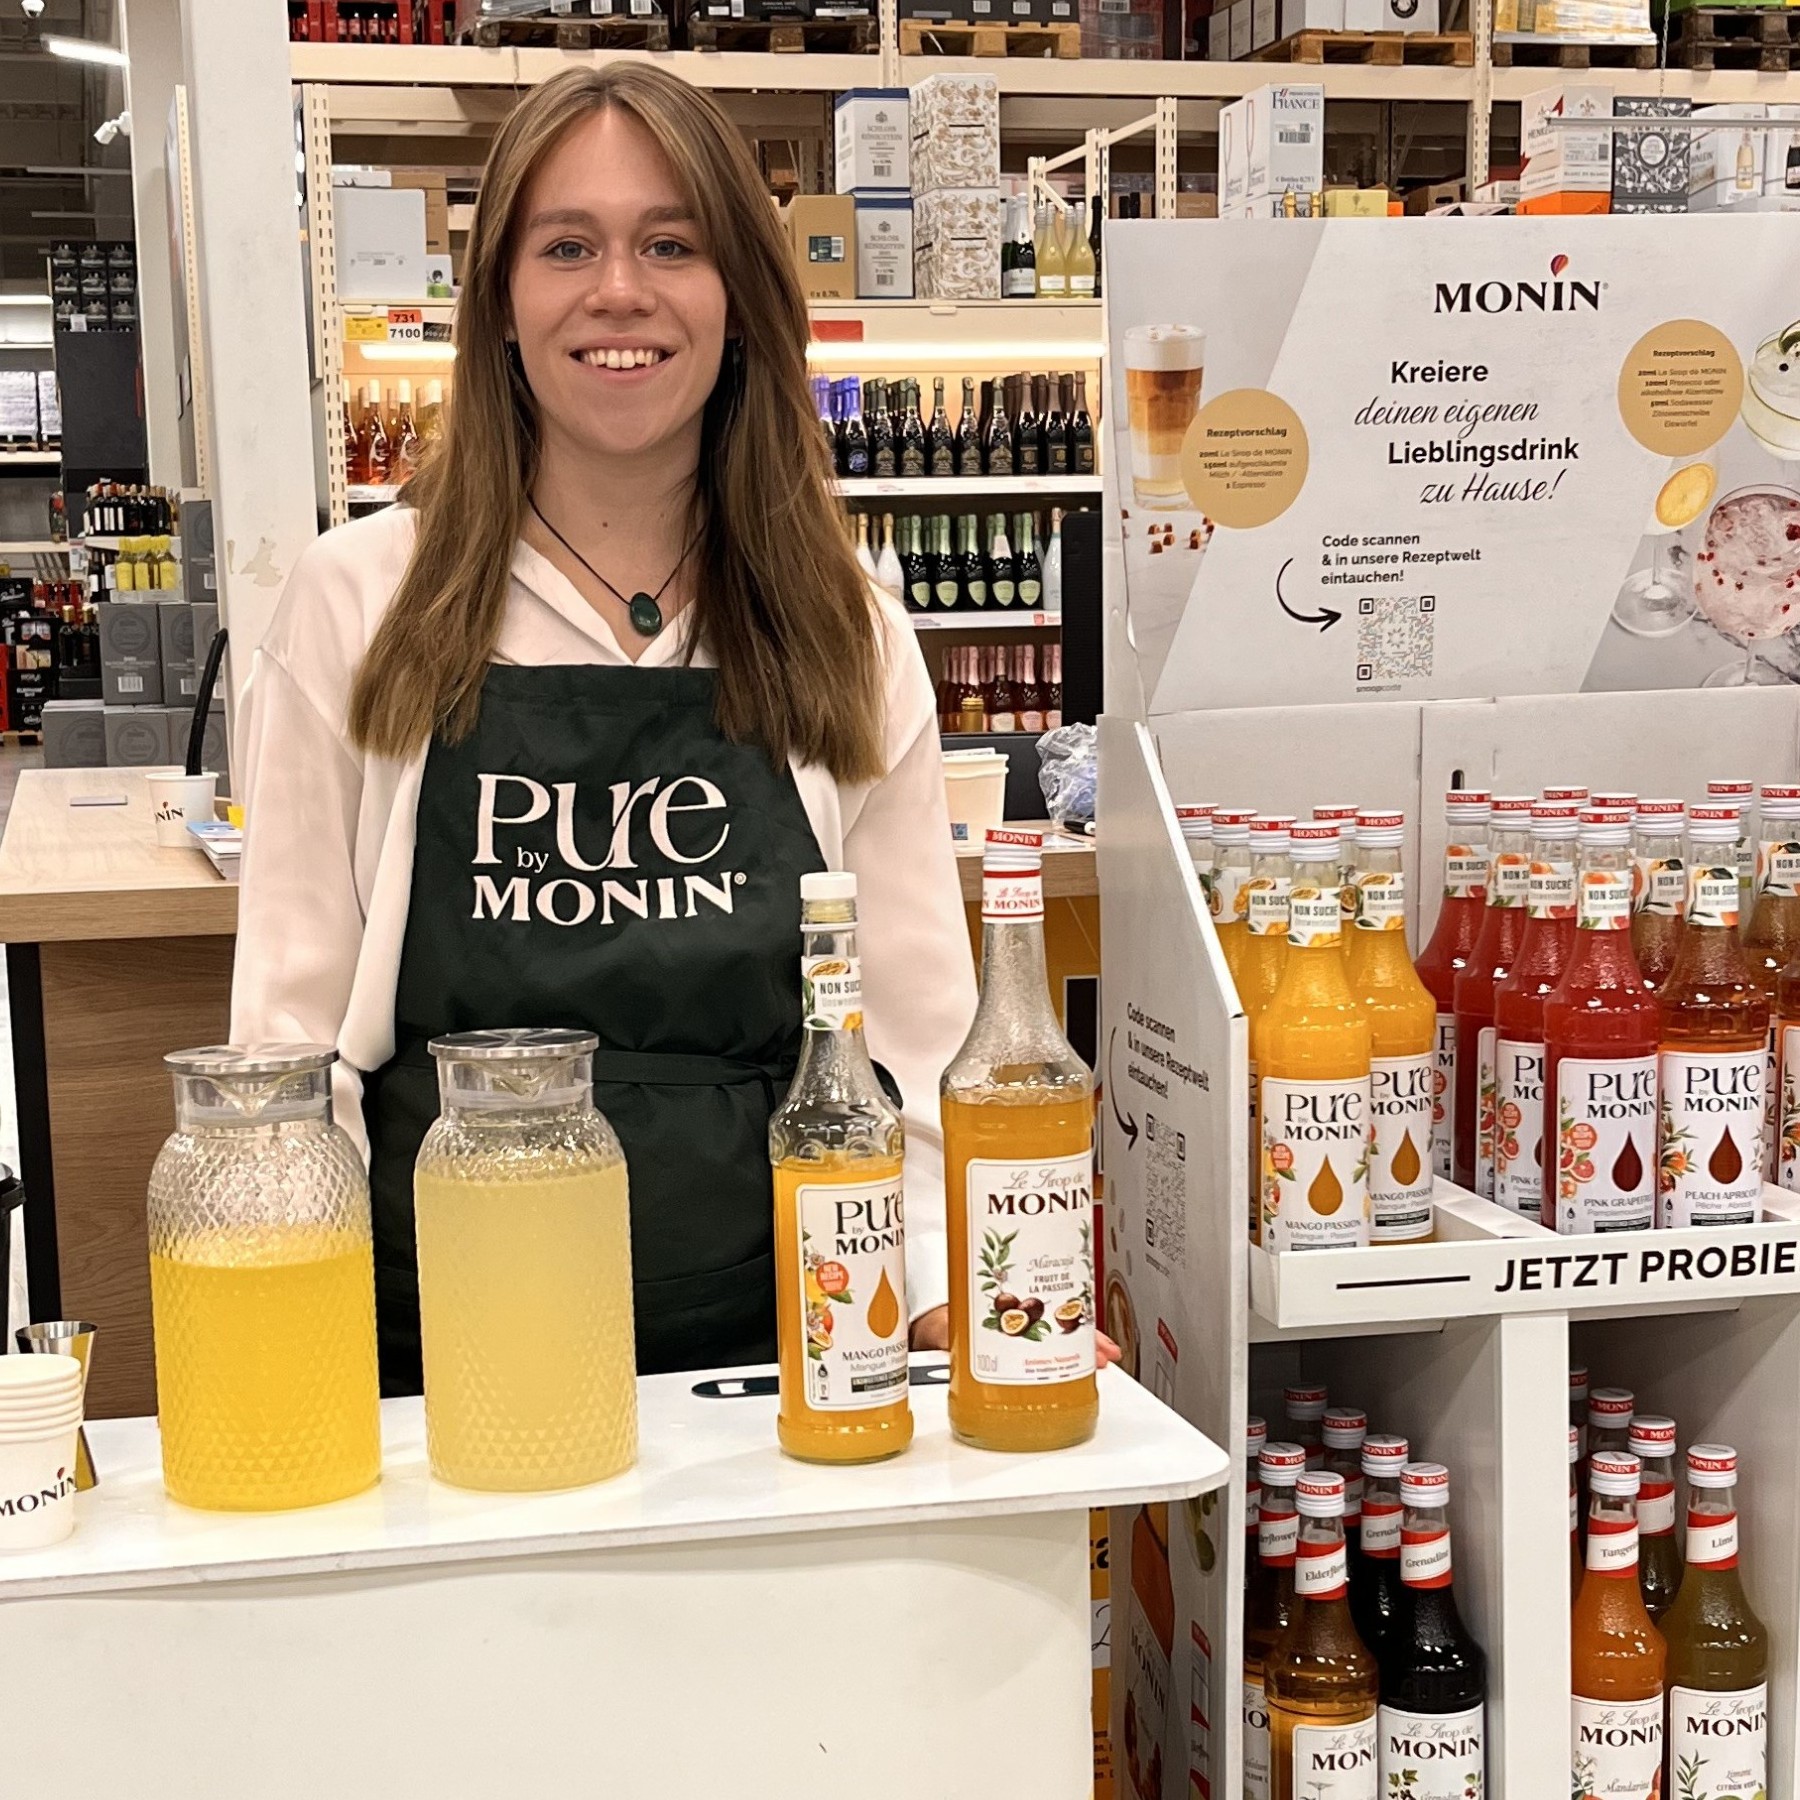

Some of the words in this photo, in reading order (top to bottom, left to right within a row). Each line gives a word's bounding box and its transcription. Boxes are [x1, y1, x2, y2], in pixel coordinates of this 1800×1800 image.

[1272, 91, 1320, 110] FRANCE
[394, 314, 415, 323] 731
[390, 328, 421, 339] 7100
[1653, 349, 1716, 358] Rezeptvorschlag
[1391, 360, 1489, 384] Kreiere
[1354, 396, 1438, 425] deinen
[1444, 398, 1539, 439] eigenen
[1206, 427, 1287, 439] Rezeptvorschlag
[1388, 437, 1580, 468] Lieblingsdrink
[1420, 483, 1454, 504] zu
[1461, 468, 1568, 503] Hause!
[1322, 535, 1358, 548] Code
[1362, 534, 1420, 546] scannen
[1321, 554, 1332, 566] &
[1336, 553, 1348, 565] in
[1351, 553, 1399, 565] unsere
[1402, 549, 1481, 566] Rezeptwelt
[1321, 569, 1404, 585] eintauchen!
[471, 772, 730, 872] Pure
[991, 831, 1038, 845] MONIN
[517, 846, 549, 874] by
[994, 899, 1040, 910] MONIN
[820, 982, 841, 994] NON
[1127, 1002, 1144, 1027] Code
[1145, 1016, 1175, 1043] scannen
[1370, 1065, 1432, 1098] Pure
[1685, 1064, 1760, 1096] Pure
[1284, 1092, 1362, 1124] Pure
[1684, 1096, 1760, 1113] MONIN
[1283, 1123, 1362, 1141] MONIN
[1002, 1170, 1029, 1190] Le
[1032, 1168, 1071, 1192] Sirop
[987, 1186, 1090, 1216] MONIN
[1369, 1192, 1405, 1202] MANGO
[1584, 1199, 1609, 1208] PINK
[1685, 1190, 1720, 1200] PEACH
[1285, 1220, 1323, 1231] MANGO
[1324, 1219, 1362, 1231] PASSION
[1494, 1253, 1628, 1293] JETZT
[1639, 1241, 1798, 1284] PROBIE
[1034, 1274, 1058, 1283] FRUIT
[1060, 1272, 1070, 1280] DE
[1029, 1285, 1040, 1294] LA
[1042, 1282, 1074, 1293] PASSION
[842, 1347, 884, 1362] MANGO
[1711, 1535, 1734, 1549] Lime
[1405, 1550, 1449, 1568] Grenadine
[1400, 1722, 1421, 1738] Le
[1425, 1722, 1460, 1742] Sirop
[1462, 1724, 1473, 1736] de
[1390, 1735, 1480, 1760] MONIN
